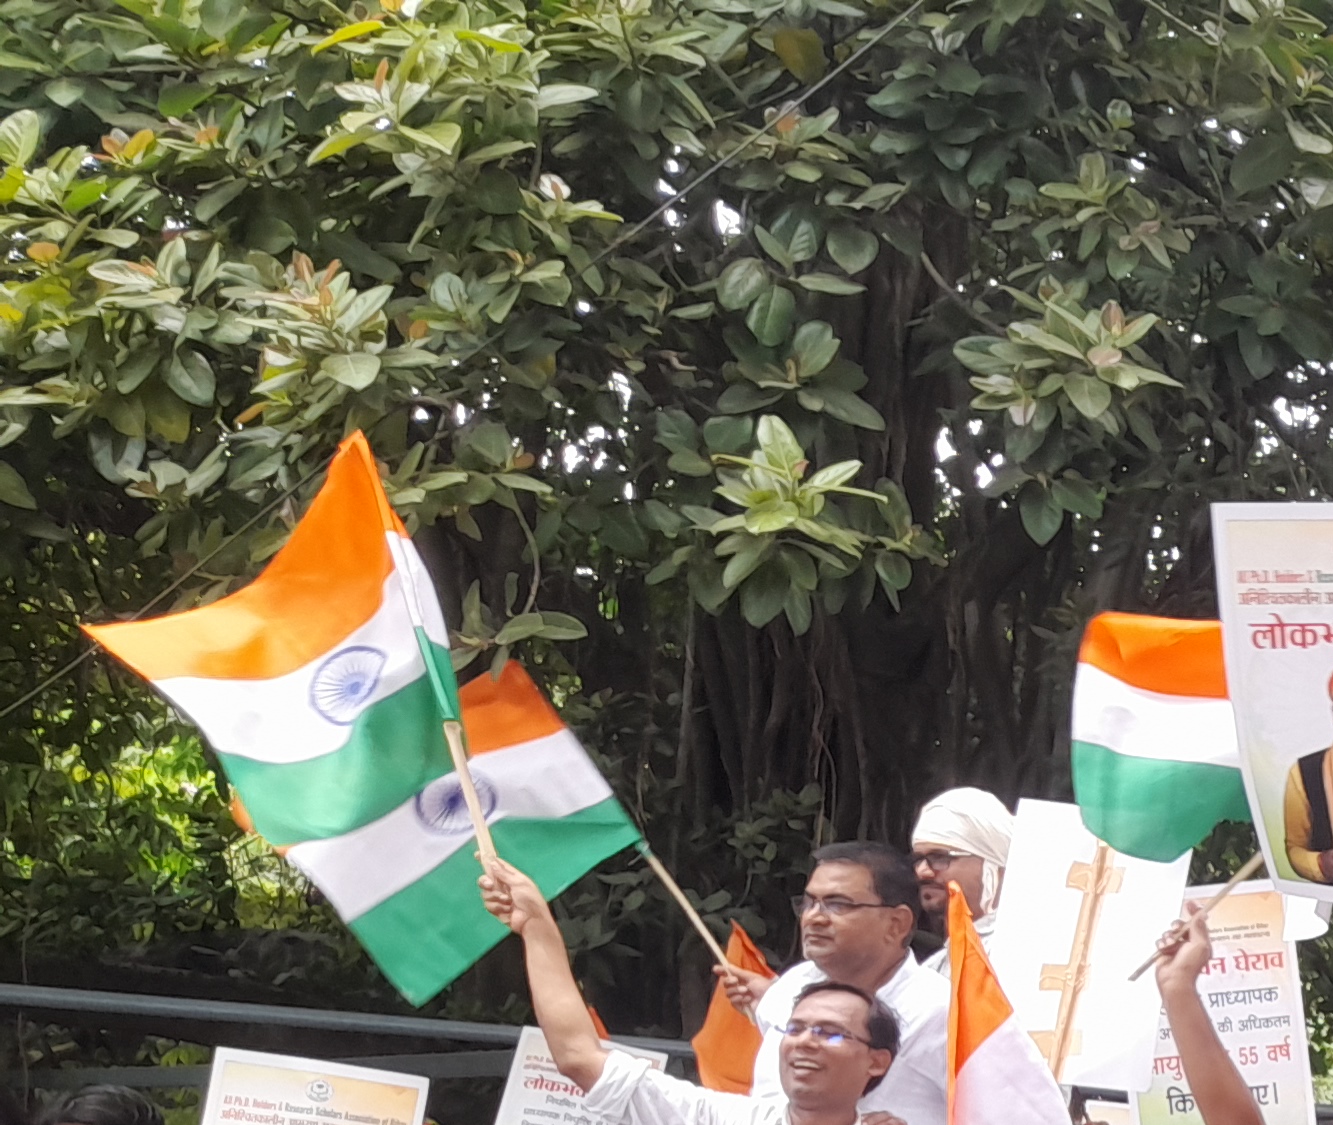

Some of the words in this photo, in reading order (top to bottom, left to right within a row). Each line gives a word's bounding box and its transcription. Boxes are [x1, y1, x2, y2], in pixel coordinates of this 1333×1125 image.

[1233, 949, 1284, 972] घेराव
[1208, 987, 1279, 1008] प्राध्यापक
[1217, 1016, 1233, 1033] की
[1238, 1015, 1291, 1033] अधिकतम
[1239, 1046, 1259, 1066] 55
[1266, 1035, 1292, 1062] वर्ष
